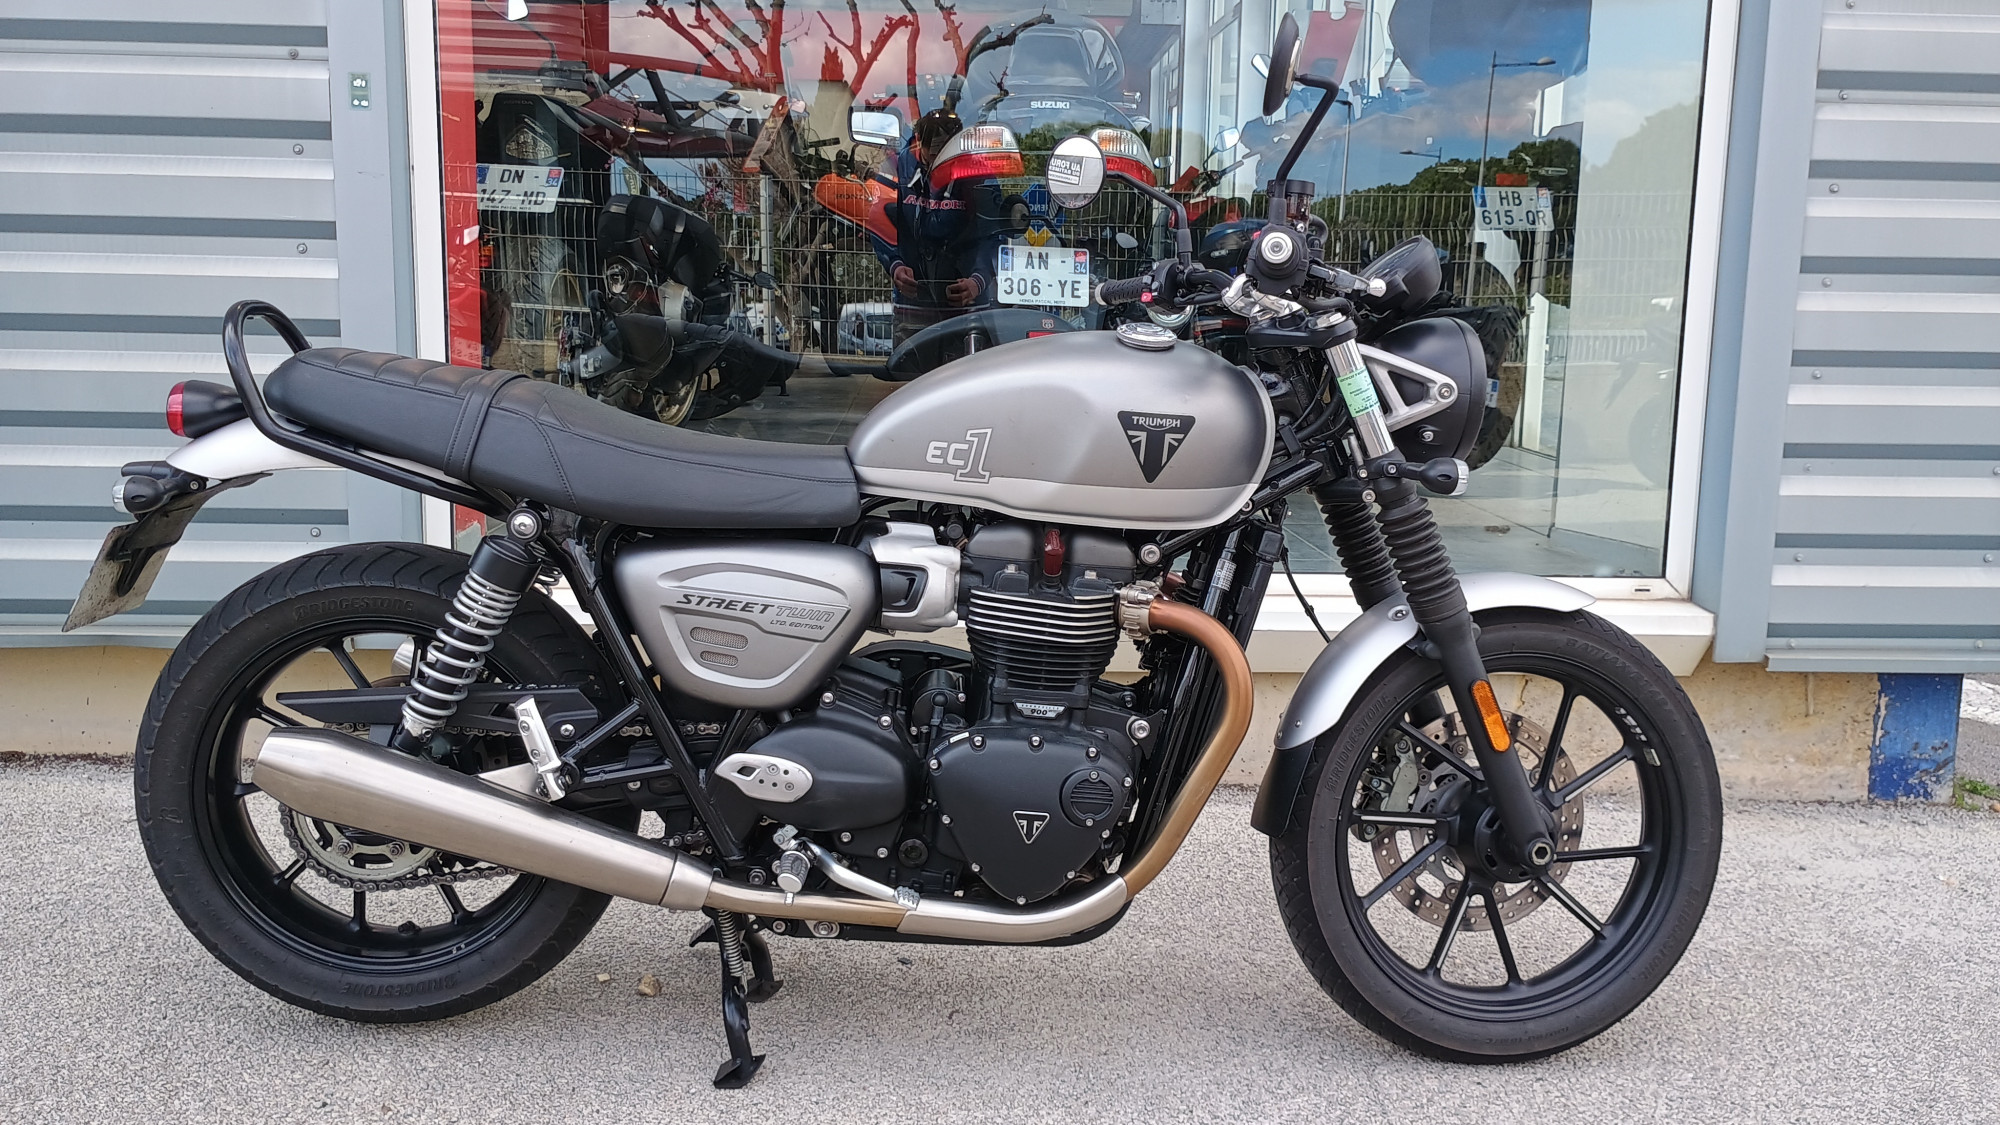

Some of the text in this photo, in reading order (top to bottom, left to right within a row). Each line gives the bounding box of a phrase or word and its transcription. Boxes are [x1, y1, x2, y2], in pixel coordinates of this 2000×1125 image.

[1030, 101, 1070, 109] SUZUKI
[500, 168, 524, 184] DN
[1498, 190, 1522, 207] HB
[1481, 209, 1547, 226] 615-QR
[1024, 251, 1049, 270] AN
[1074, 263, 1087, 274] 34
[1003, 277, 1082, 299] 306-YE
[1131, 415, 1181, 429] TRIUMPH
[925, 427, 993, 484] EC1
[676, 593, 835, 623] STREET TWIN
[770, 619, 826, 631] LTD. EDITION
[1030, 708, 1048, 716] 900
